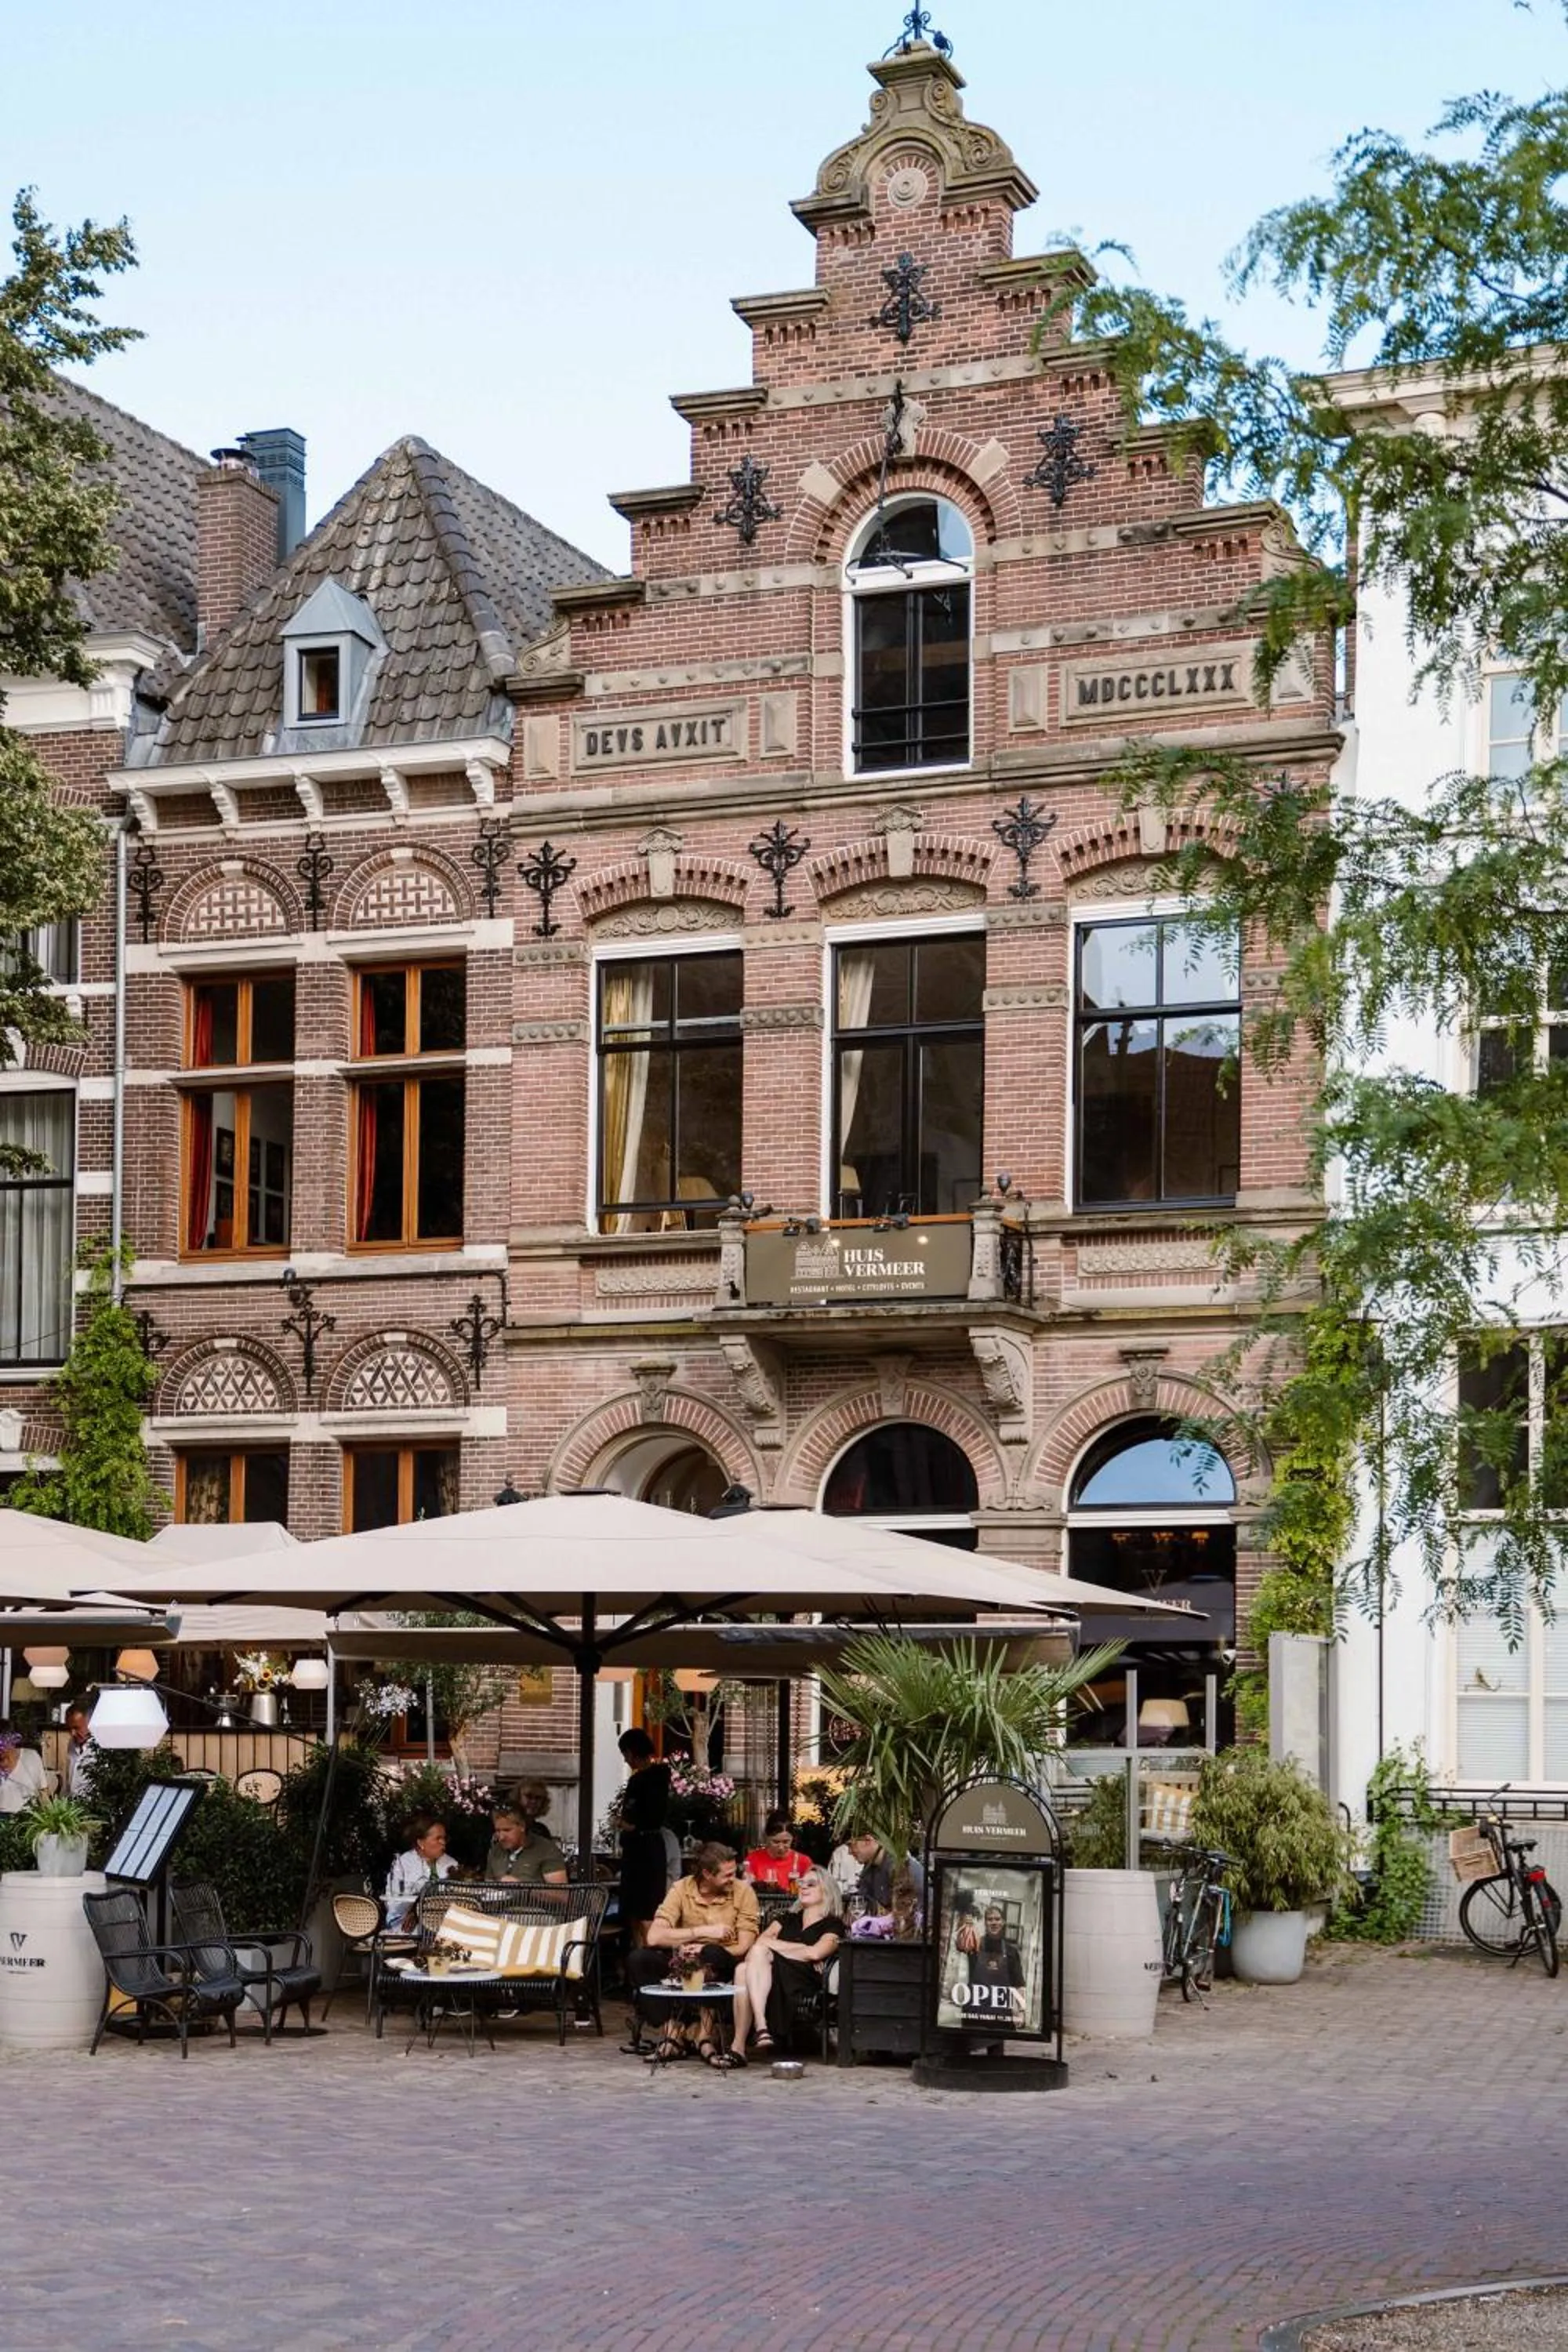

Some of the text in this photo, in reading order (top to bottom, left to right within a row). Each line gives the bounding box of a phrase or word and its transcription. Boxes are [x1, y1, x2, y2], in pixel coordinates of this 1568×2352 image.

[1078, 664, 1234, 705] MDCCCLXXX
[586, 719, 725, 755] DEVS AVXIT
[844, 1248, 884, 1262] HUIS
[844, 1261, 925, 1276] VERMEER
[789, 1285, 829, 1294] RESTAURANT
[835, 1283, 855, 1293] HOTEL
[901, 1281, 925, 1290] EVENTS
[0, 1957, 45, 1967] ERMEER
[951, 1982, 1027, 2009] OPEN
